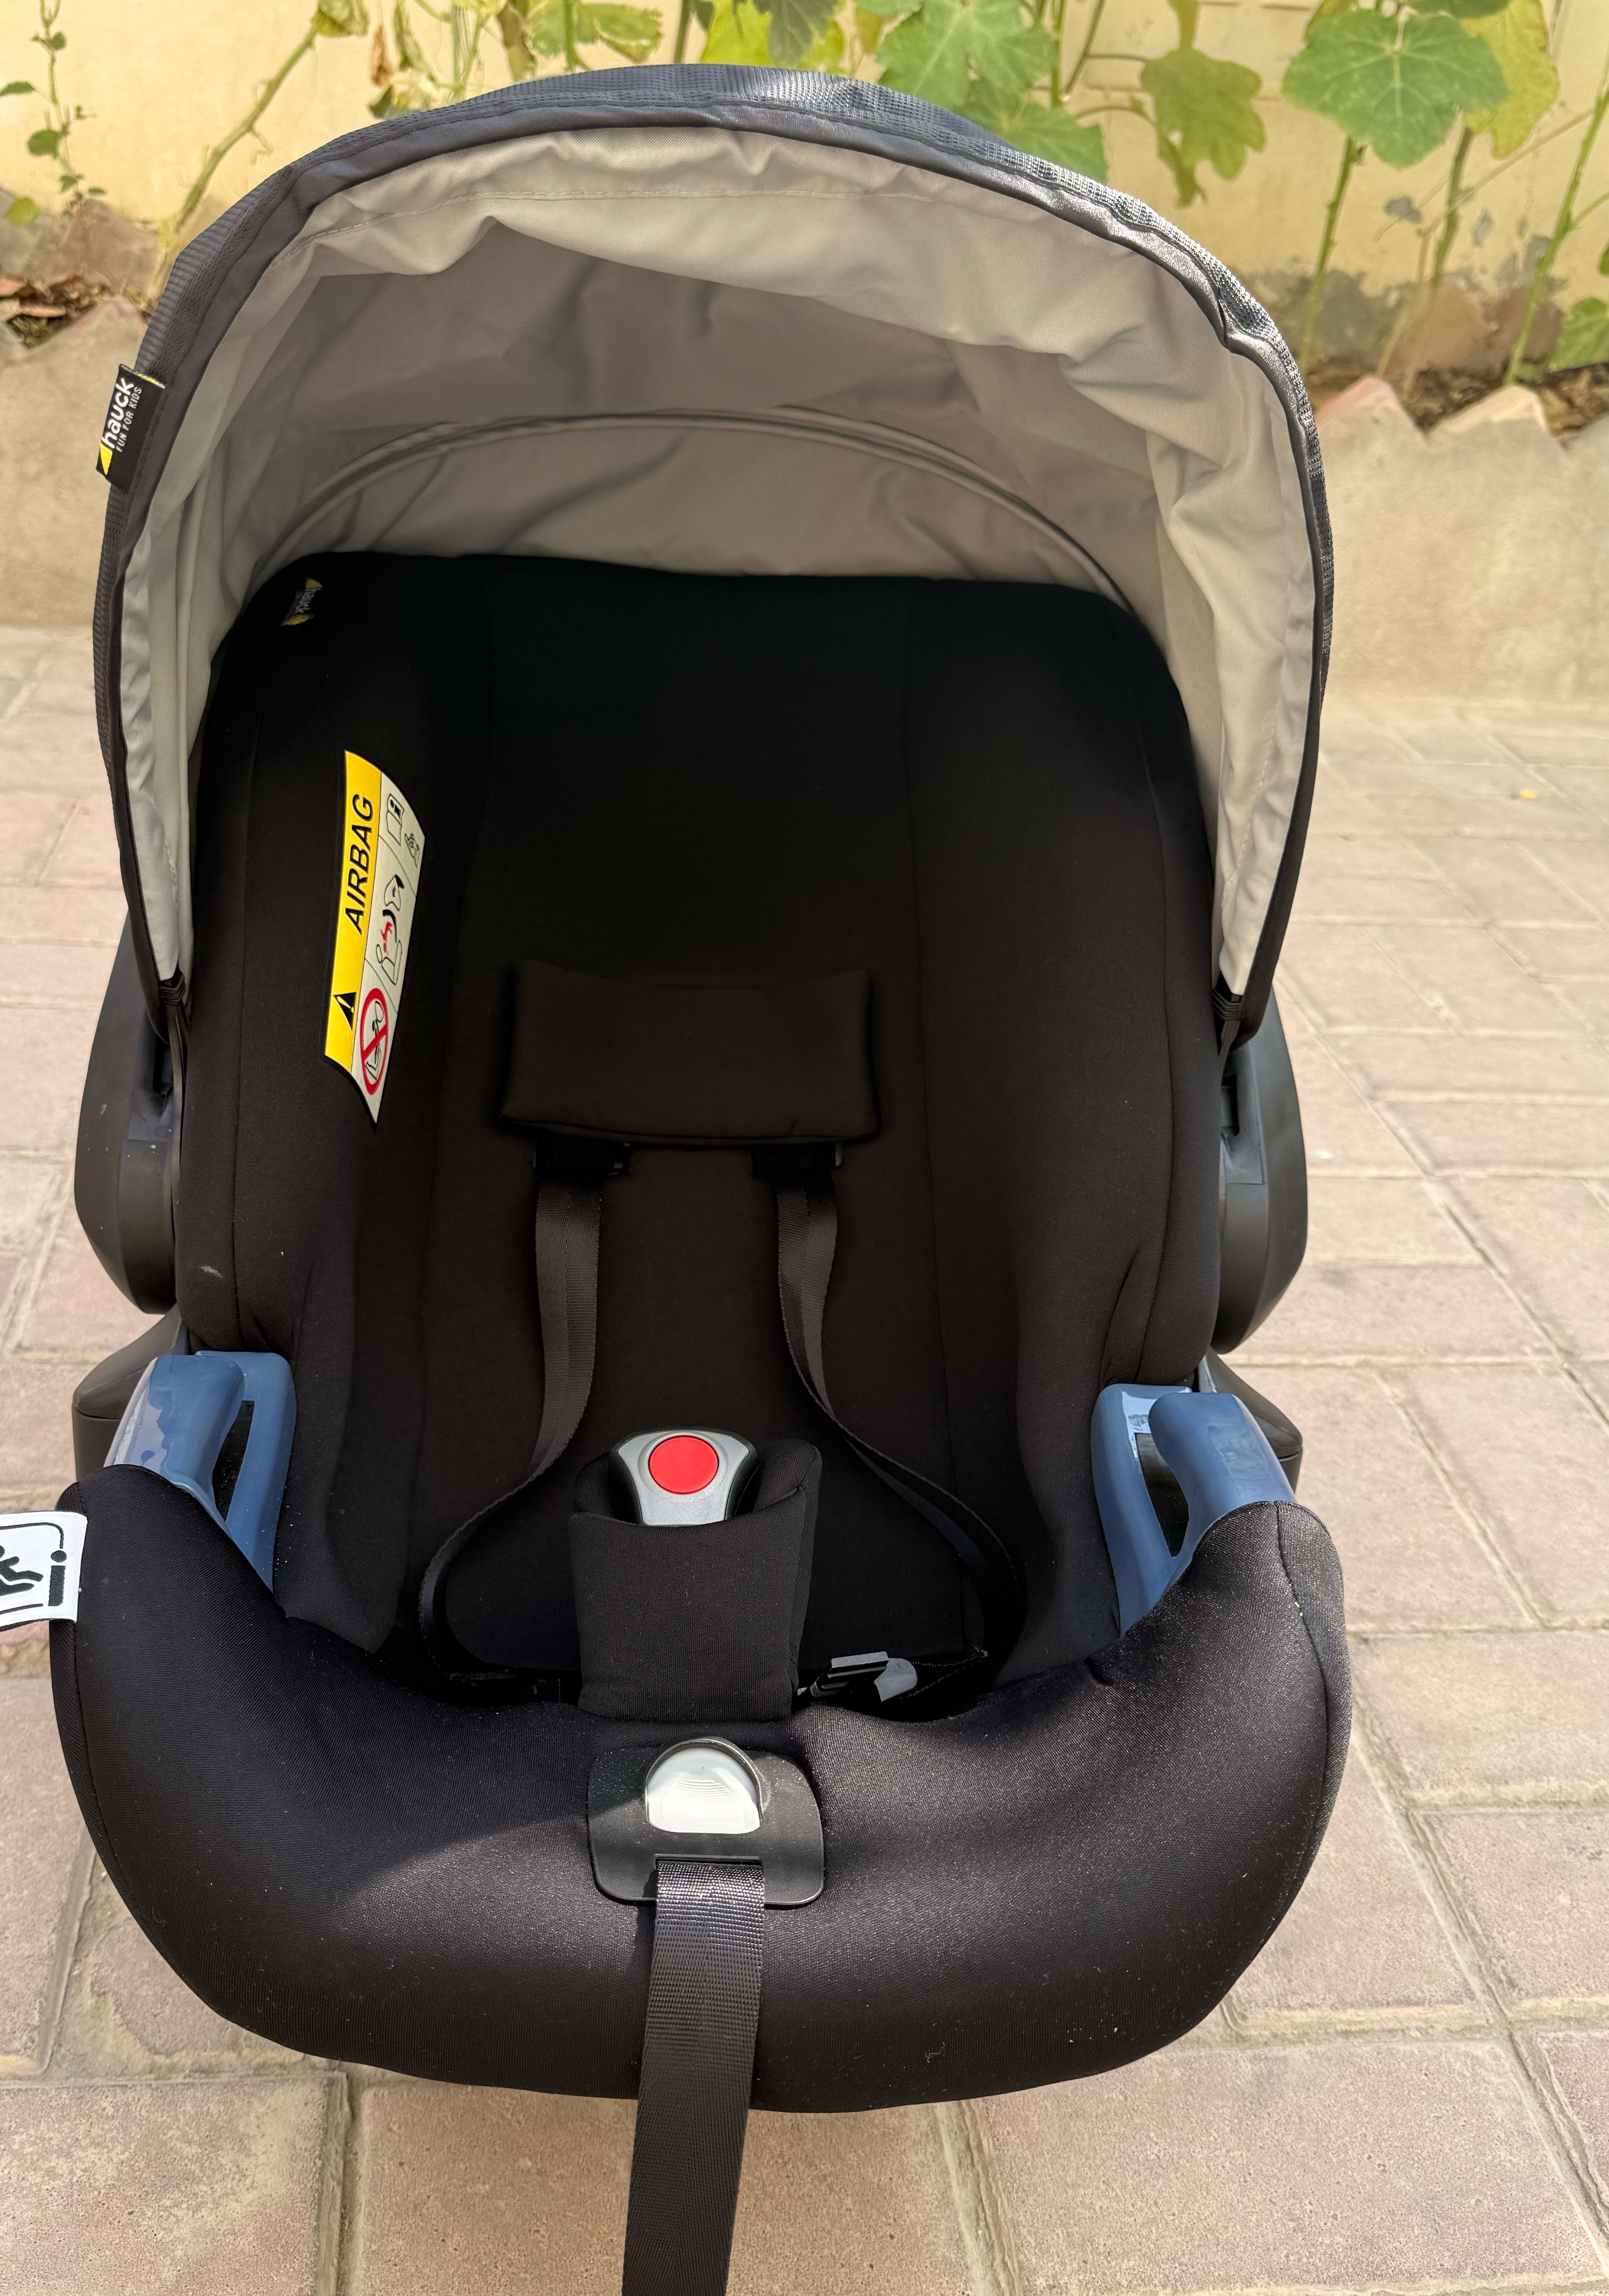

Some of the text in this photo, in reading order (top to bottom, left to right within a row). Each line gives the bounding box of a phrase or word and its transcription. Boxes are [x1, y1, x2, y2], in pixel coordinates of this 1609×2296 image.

[102, 378, 134, 449] hauck
[117, 386, 142, 452] FUN FOR KIDS
[346, 794, 373, 935] AIRBAG
